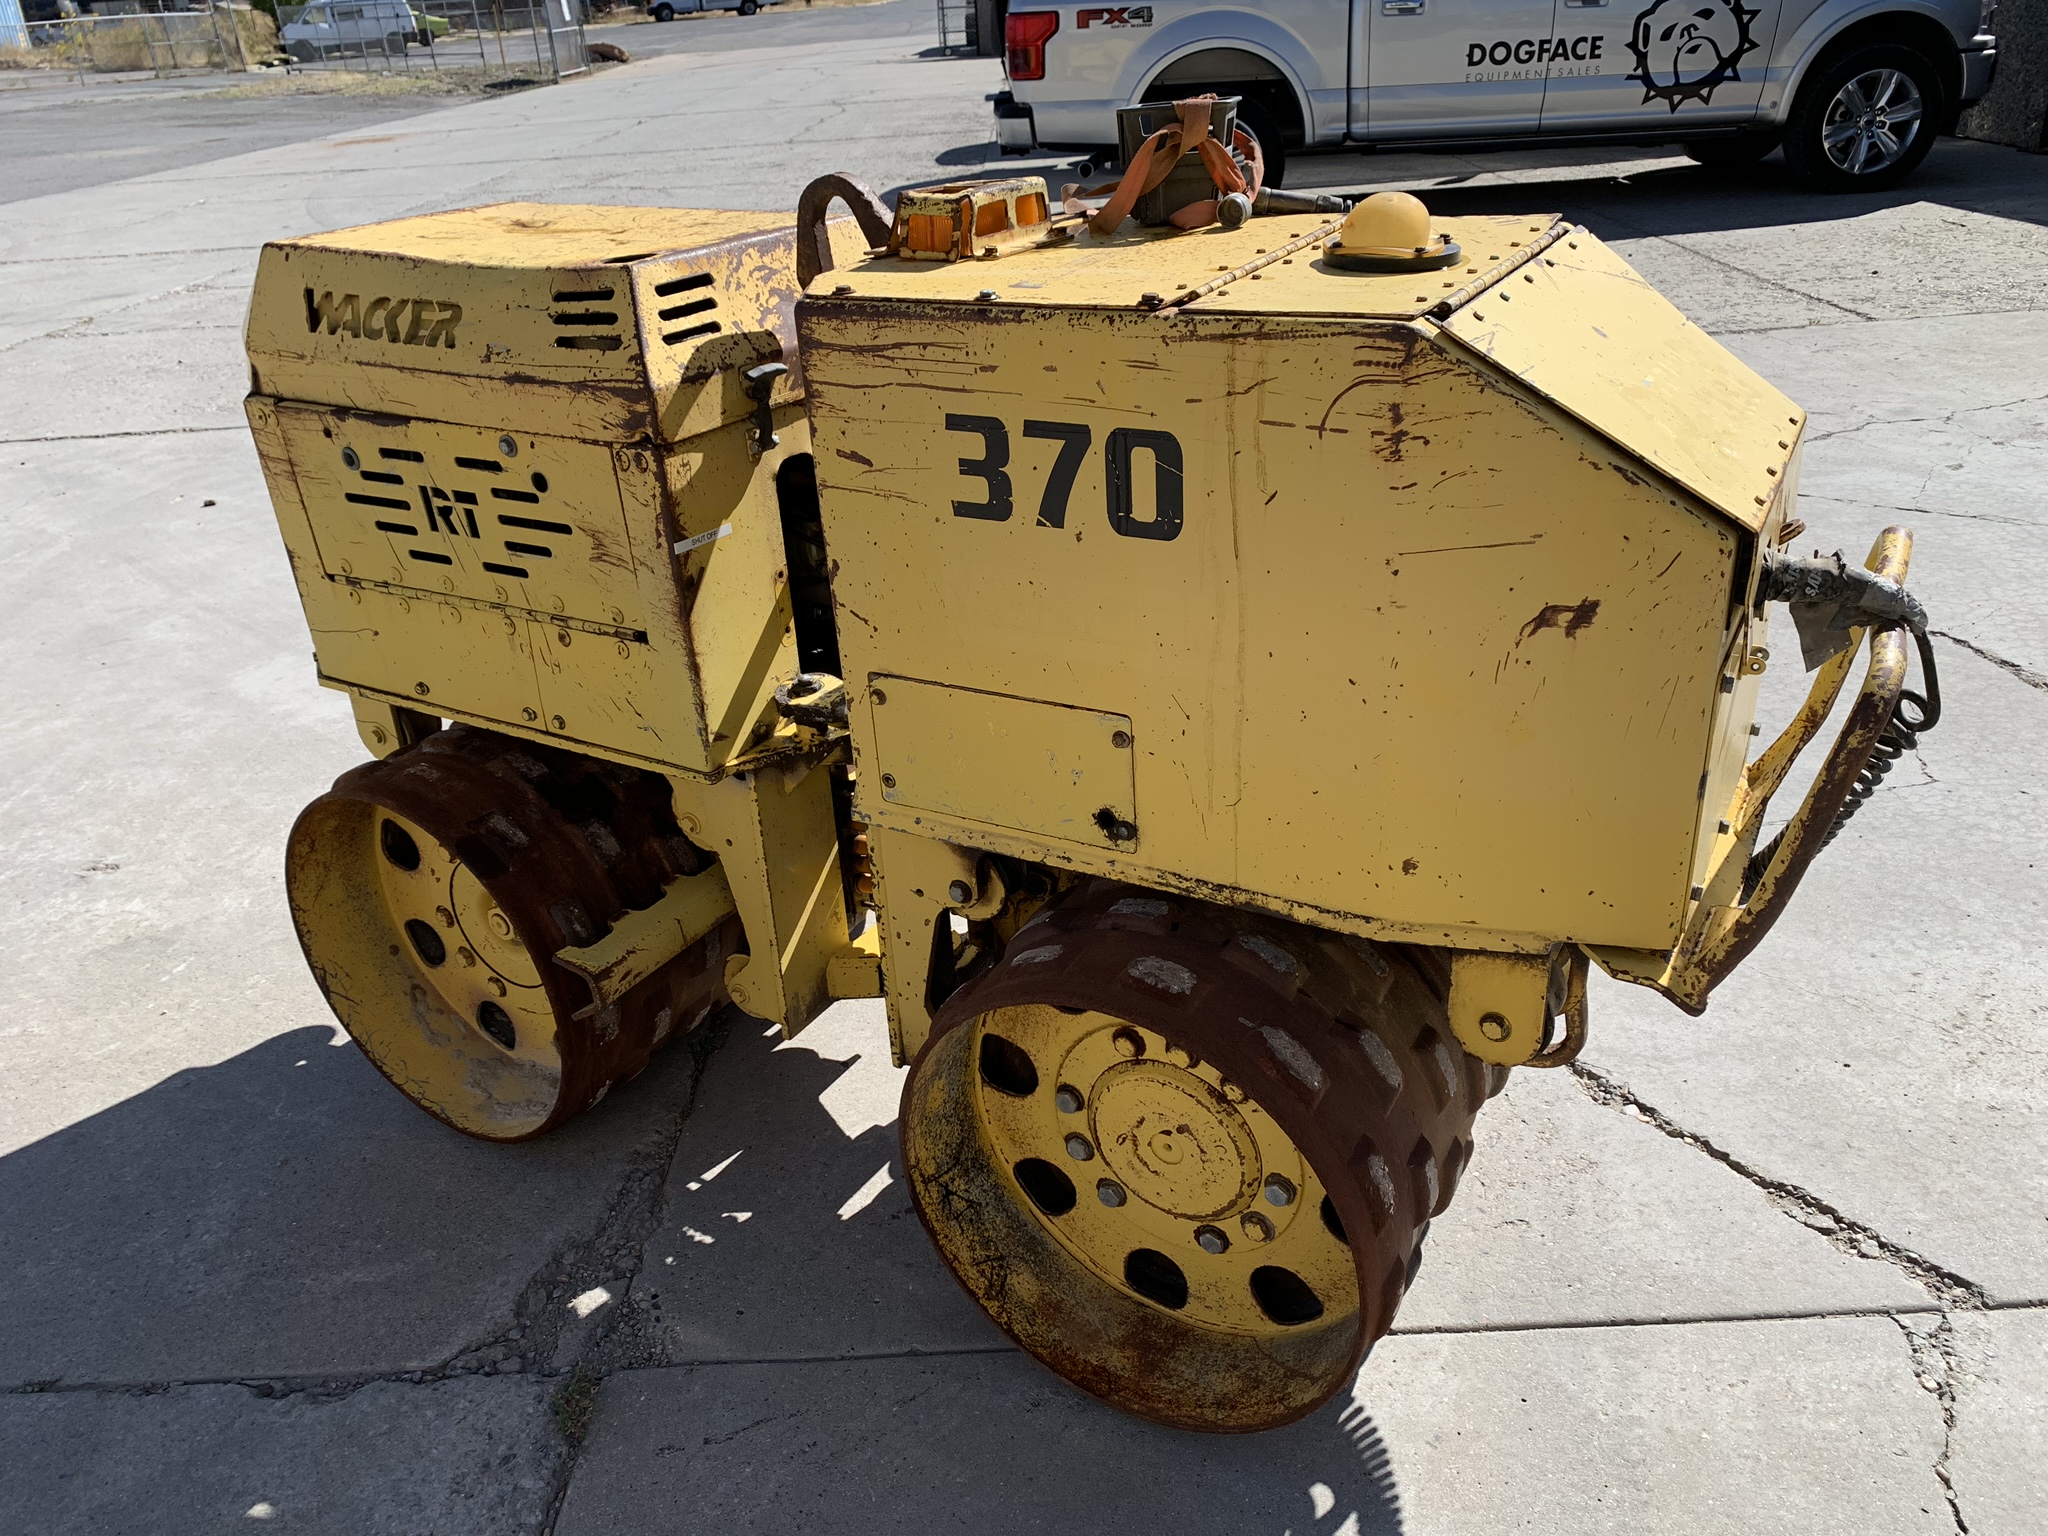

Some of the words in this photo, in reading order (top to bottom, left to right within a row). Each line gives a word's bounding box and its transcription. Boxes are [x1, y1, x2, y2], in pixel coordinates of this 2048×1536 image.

[1076, 6, 1153, 29] FX4
[1466, 35, 1604, 67] DOGFACE
[1465, 68, 1552, 82] EQUIPMENT
[1558, 65, 1600, 77] SALES
[303, 287, 462, 349] WACKER
[945, 413, 1184, 541] 370
[418, 485, 481, 539] RT
[692, 535, 706, 546] SHUT
[707, 531, 717, 539] OFF
